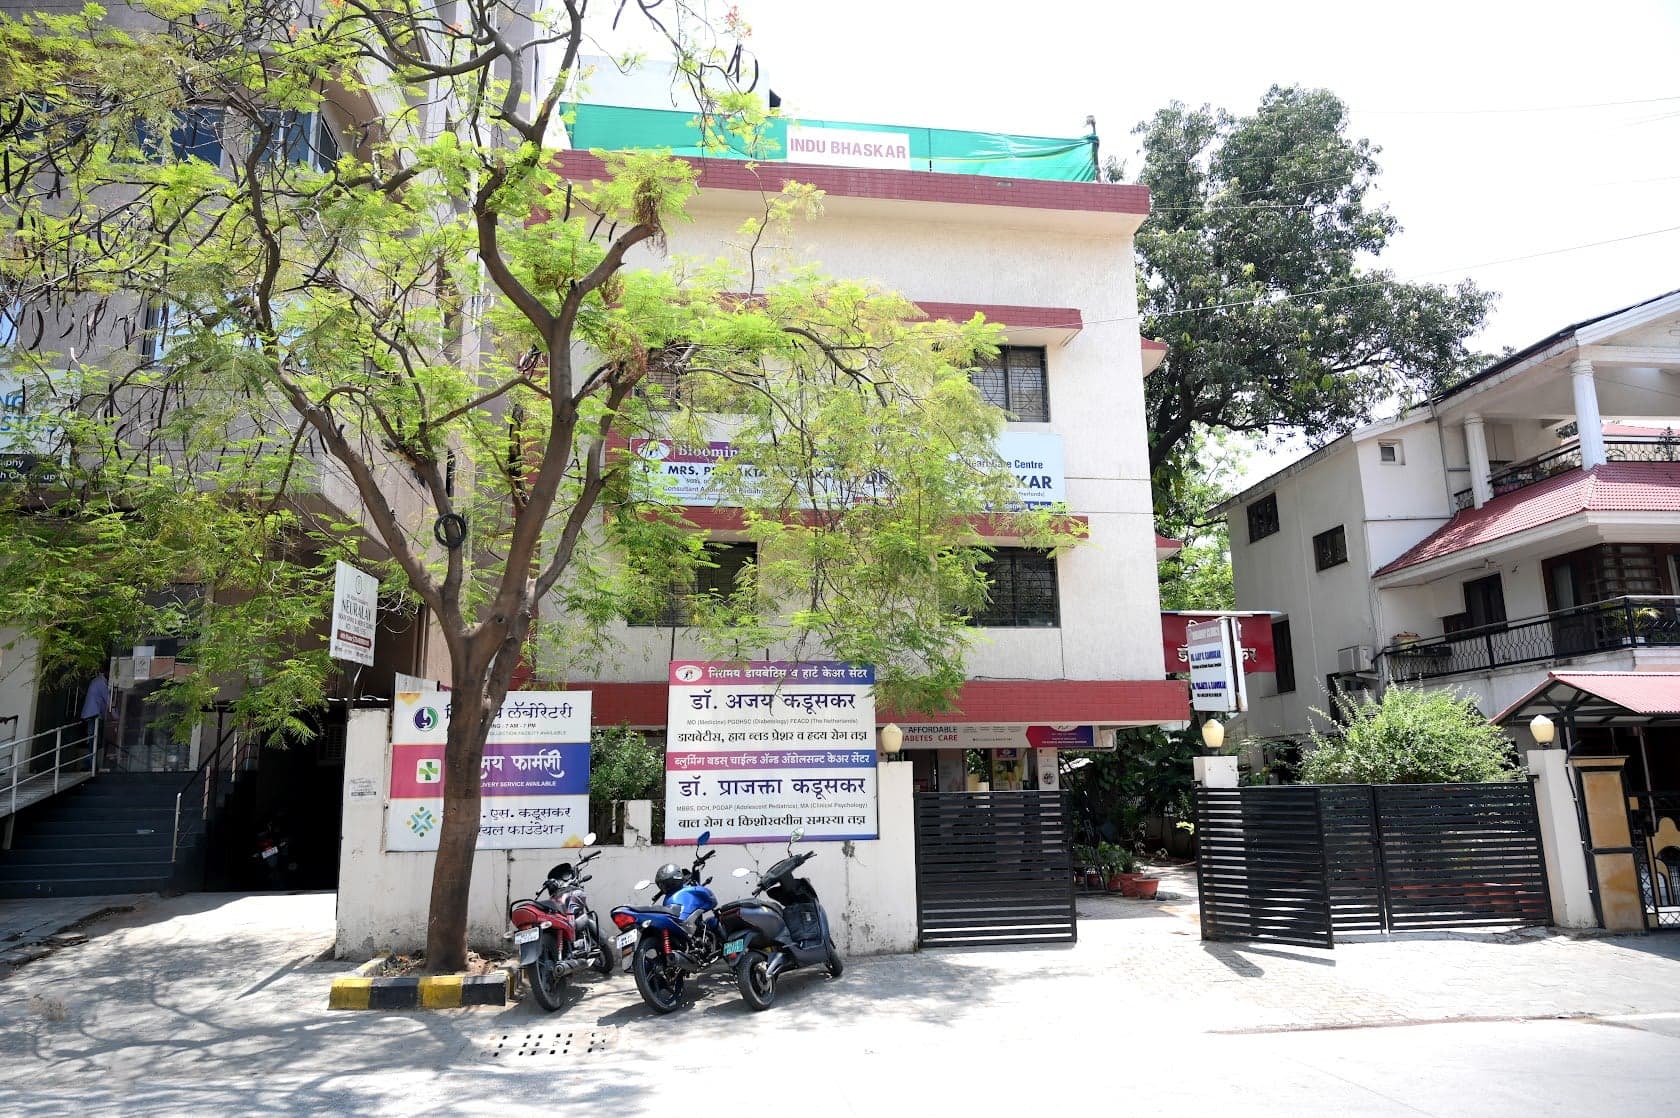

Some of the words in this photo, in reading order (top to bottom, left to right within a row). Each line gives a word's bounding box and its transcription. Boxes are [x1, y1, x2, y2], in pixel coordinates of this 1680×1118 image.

[790, 137, 826, 154] INDU
[830, 141, 906, 159] BHASKAR
[1014, 459, 1044, 469] Centre
[667, 465, 699, 476] MRS.
[708, 667, 740, 678] निरामय
[802, 666, 819, 679] हार्ट
[822, 666, 845, 678] केअर
[848, 666, 868, 678] सेंटर
[689, 689, 718, 710] डॉ.
[725, 694, 774, 710] अजय
[782, 694, 856, 715] कडूसकर
[831, 729, 848, 740] रोग
[827, 752, 850, 763] केअर
[851, 751, 870, 763] सेंटर
[678, 776, 707, 796] डॉ.
[718, 779, 783, 796] प्राजक्ता
[791, 778, 866, 800] कडूसकर
[518, 807, 571, 821] कडूसकर
[704, 815, 723, 827] रोग
